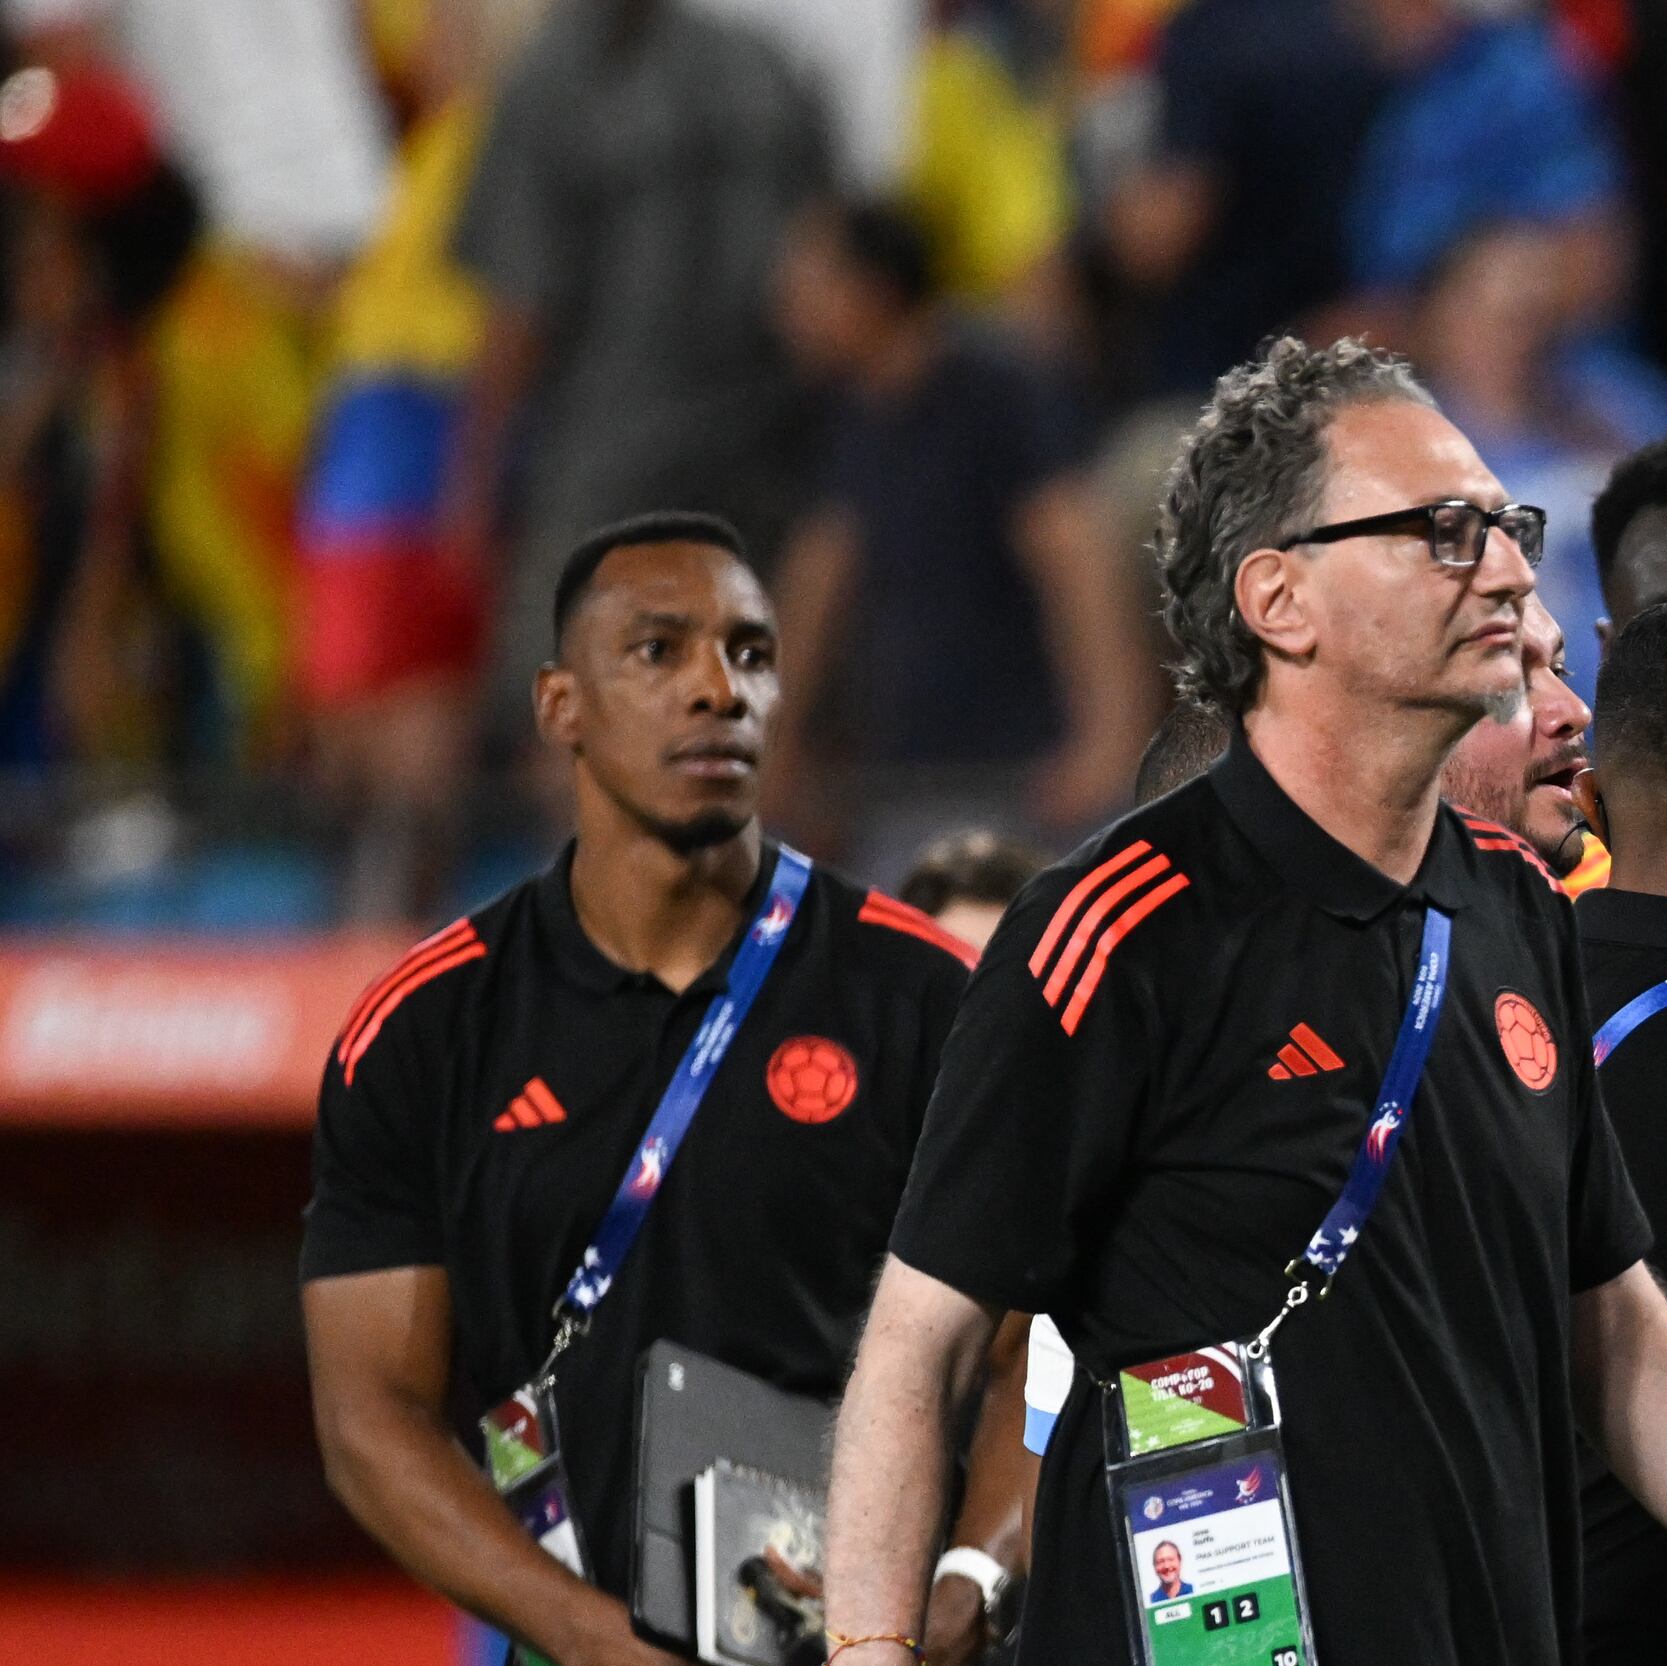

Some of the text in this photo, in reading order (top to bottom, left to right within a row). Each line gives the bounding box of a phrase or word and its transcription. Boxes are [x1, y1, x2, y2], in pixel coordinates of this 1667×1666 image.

[1214, 1540, 1251, 1556] SUPPORT
[1252, 1536, 1275, 1547] TEAM
[1210, 1599, 1254, 1624] 1 2
